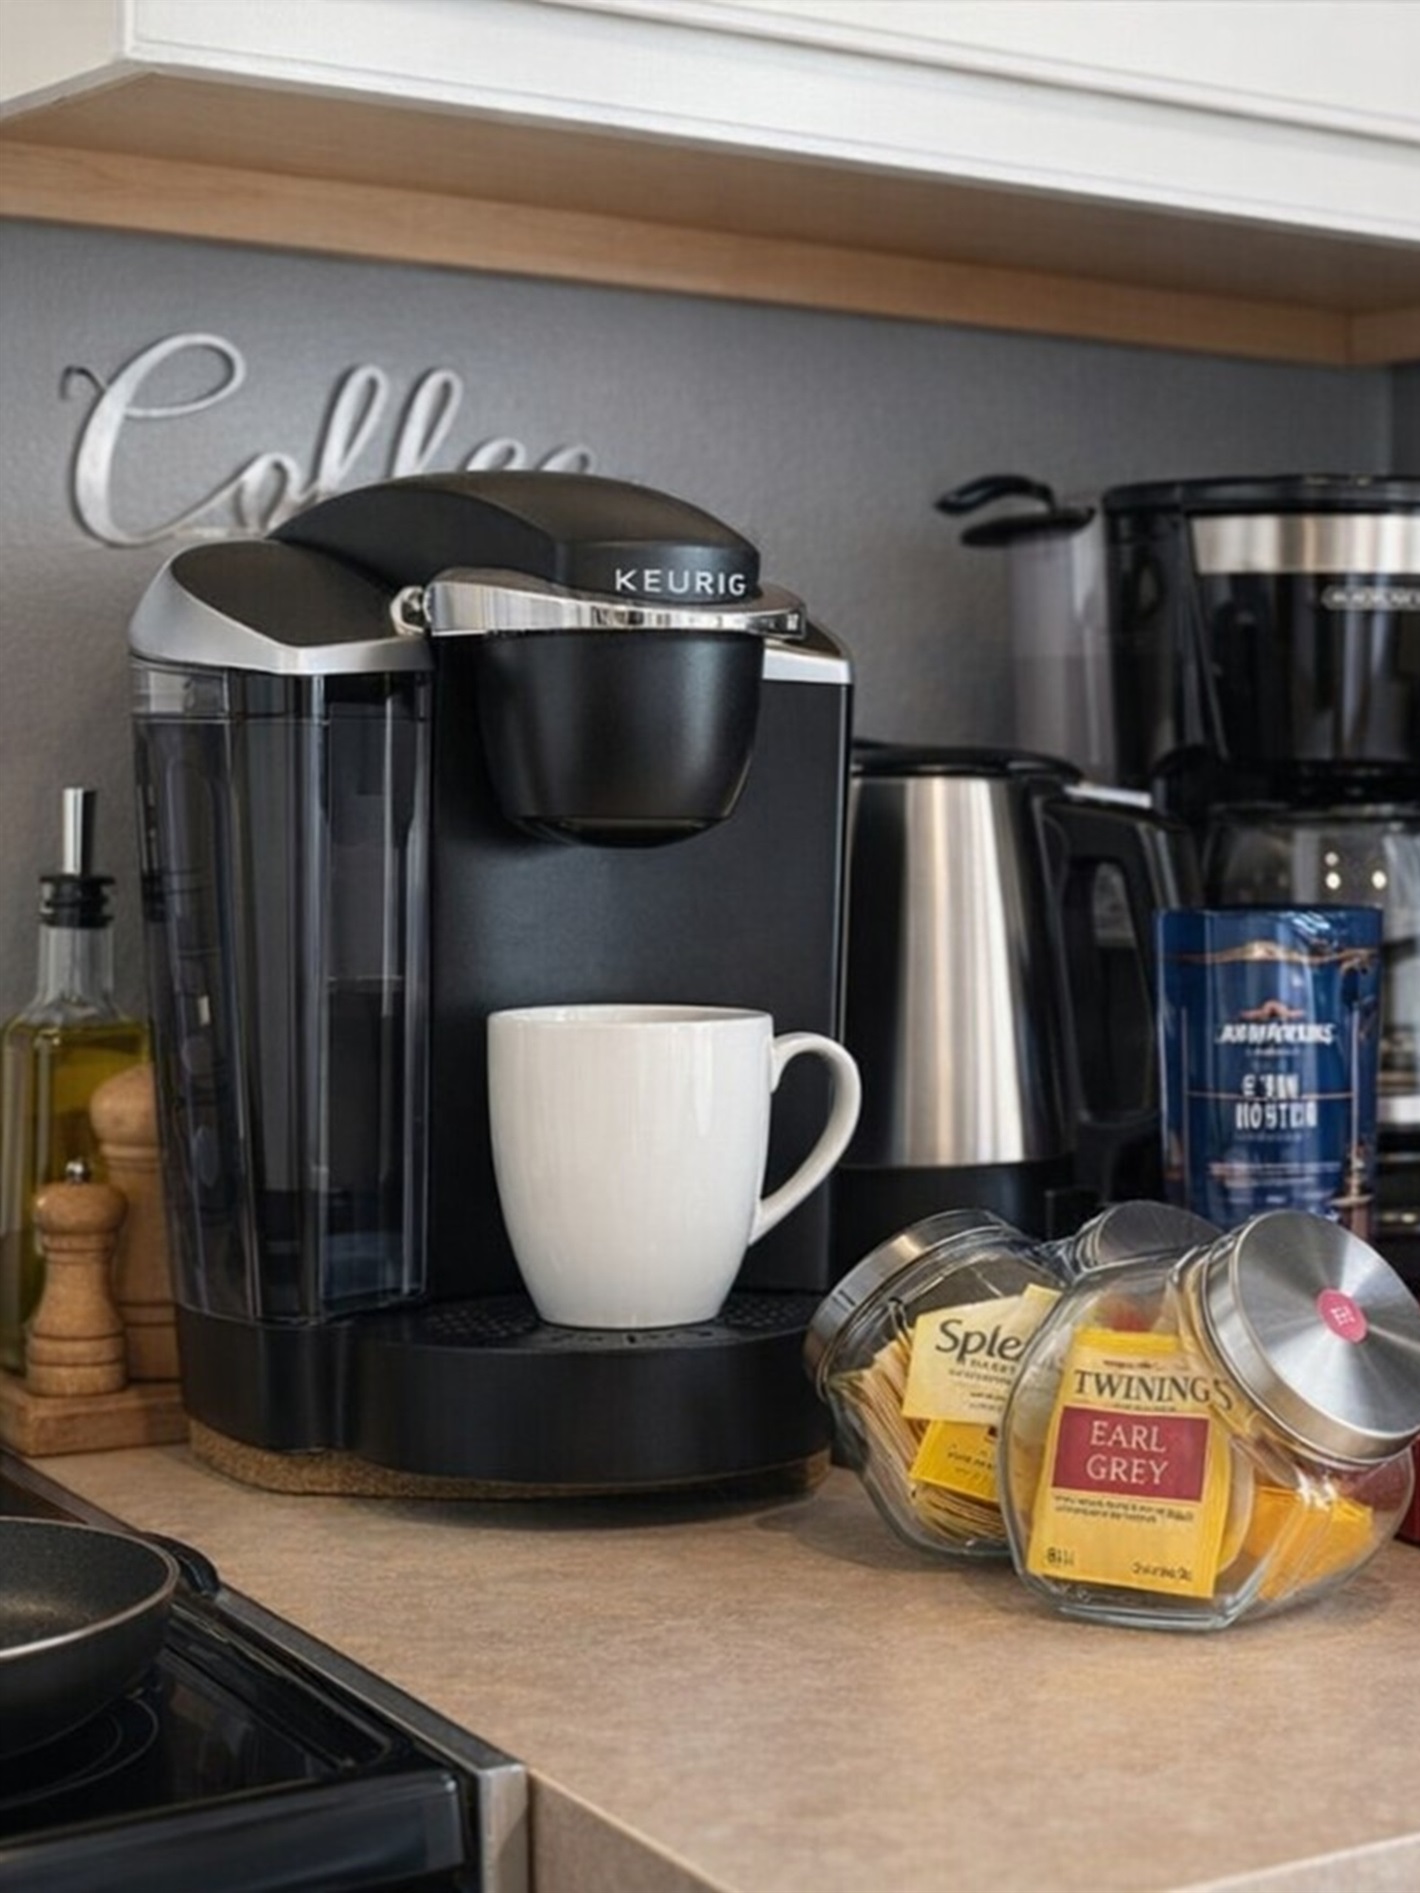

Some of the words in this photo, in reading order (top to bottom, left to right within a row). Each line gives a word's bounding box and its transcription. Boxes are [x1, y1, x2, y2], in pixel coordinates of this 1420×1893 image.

[615, 568, 747, 596] KEURIG
[1074, 1369, 1232, 1411] TWININGS
[1090, 1420, 1167, 1453] EARL
[1086, 1454, 1168, 1485] GREY
